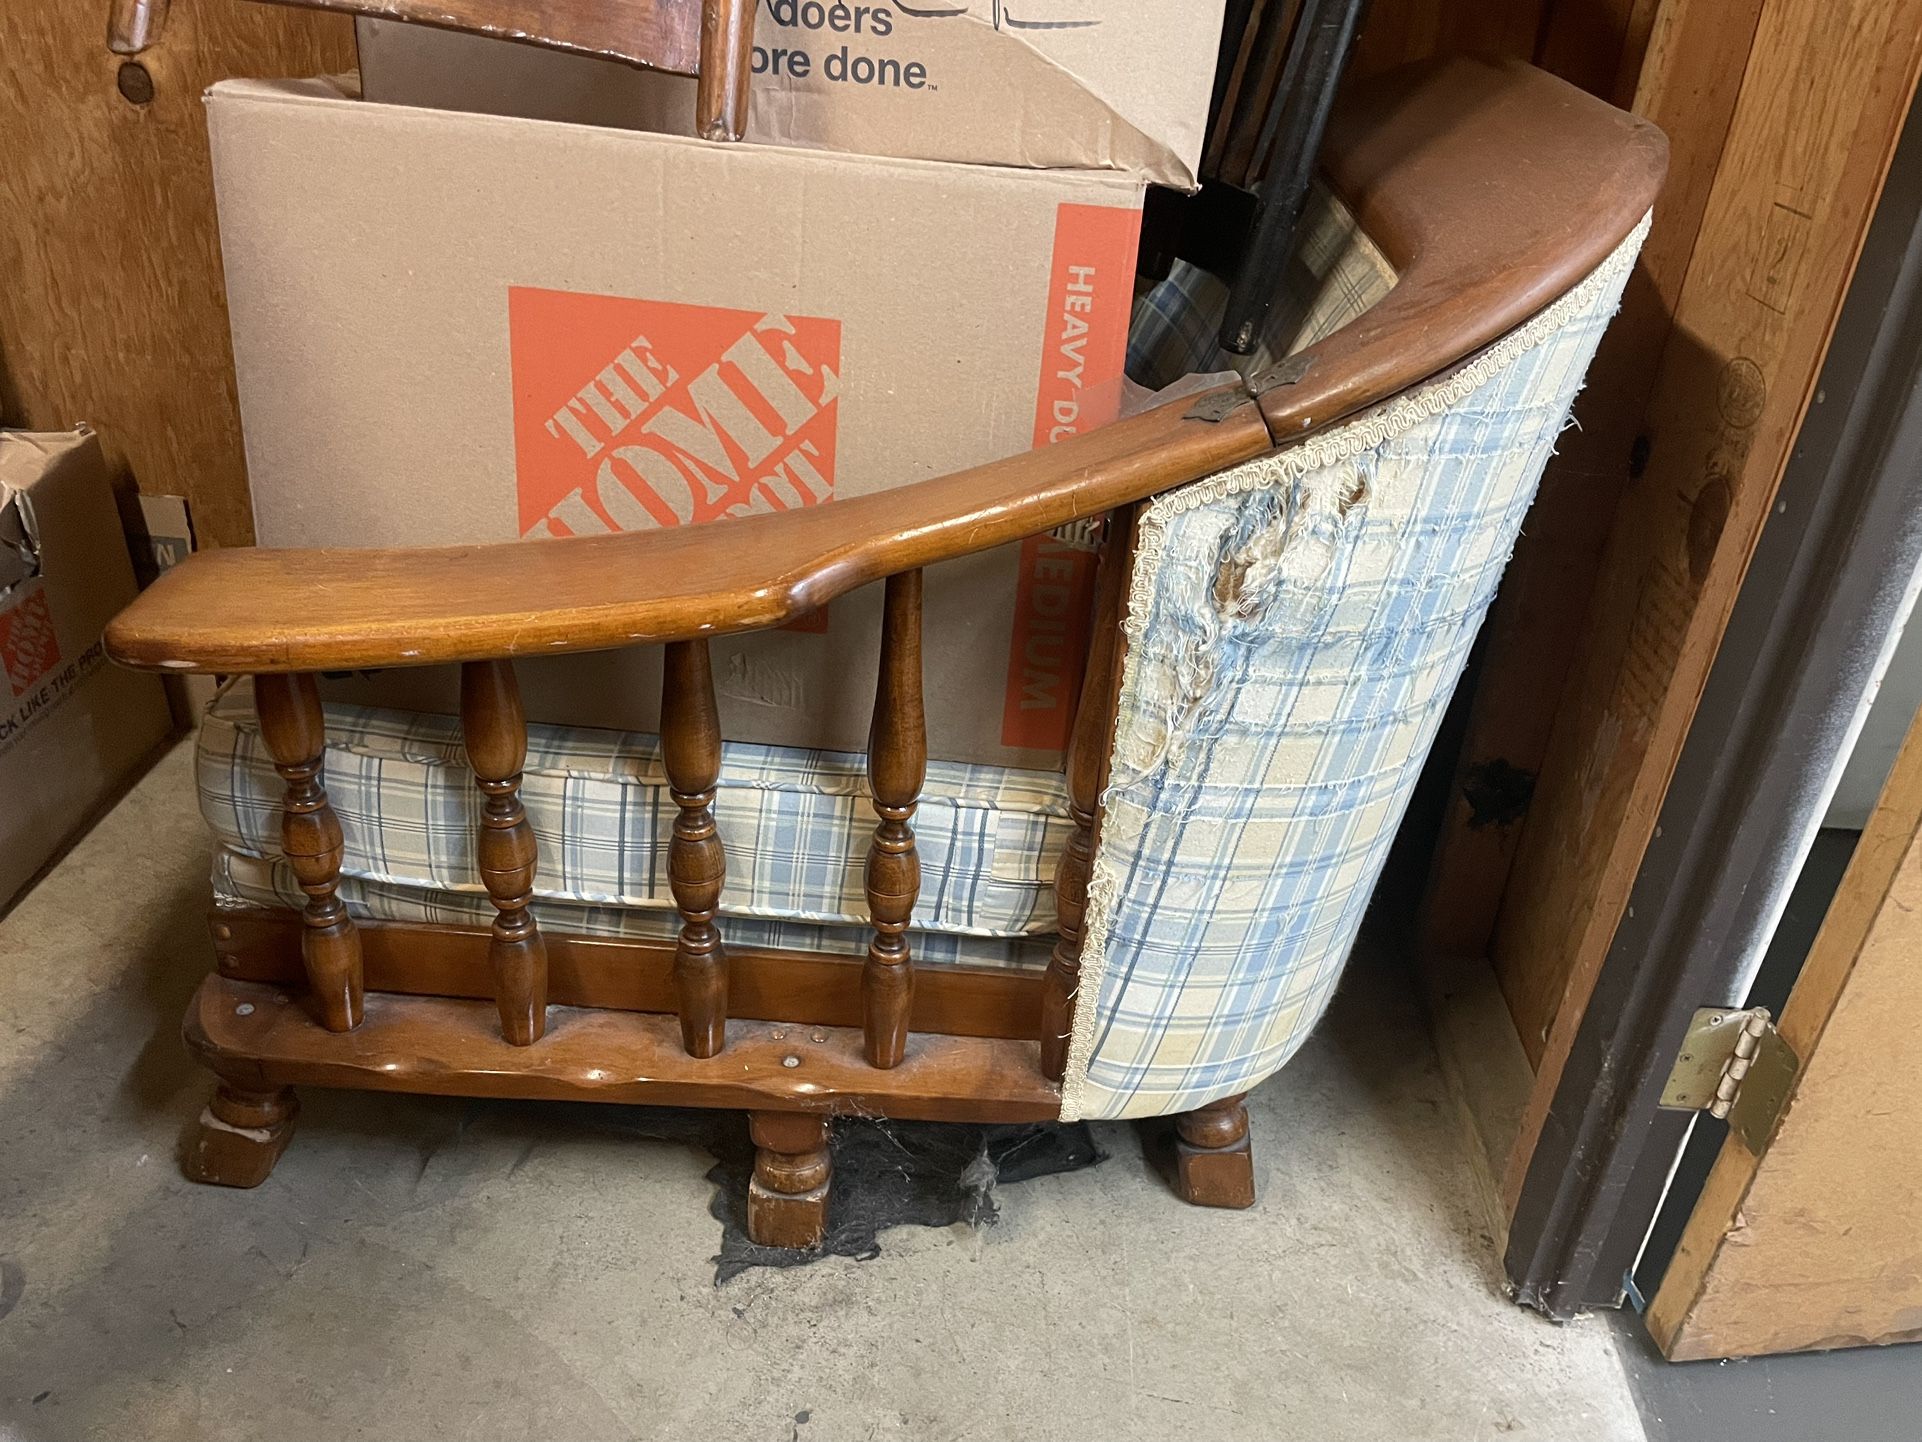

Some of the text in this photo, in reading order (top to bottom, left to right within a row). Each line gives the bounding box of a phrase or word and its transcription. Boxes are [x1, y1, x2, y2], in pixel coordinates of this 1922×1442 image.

[751, 46, 811, 78] ore
[773, 0, 893, 36] doers
[1057, 265, 1096, 389] HEAVY
[545, 334, 680, 459] THE
[0, 717, 18, 741] CK
[19, 686, 51, 722] LIKE
[51, 664, 77, 692] THE
[78, 640, 102, 671] PRO
